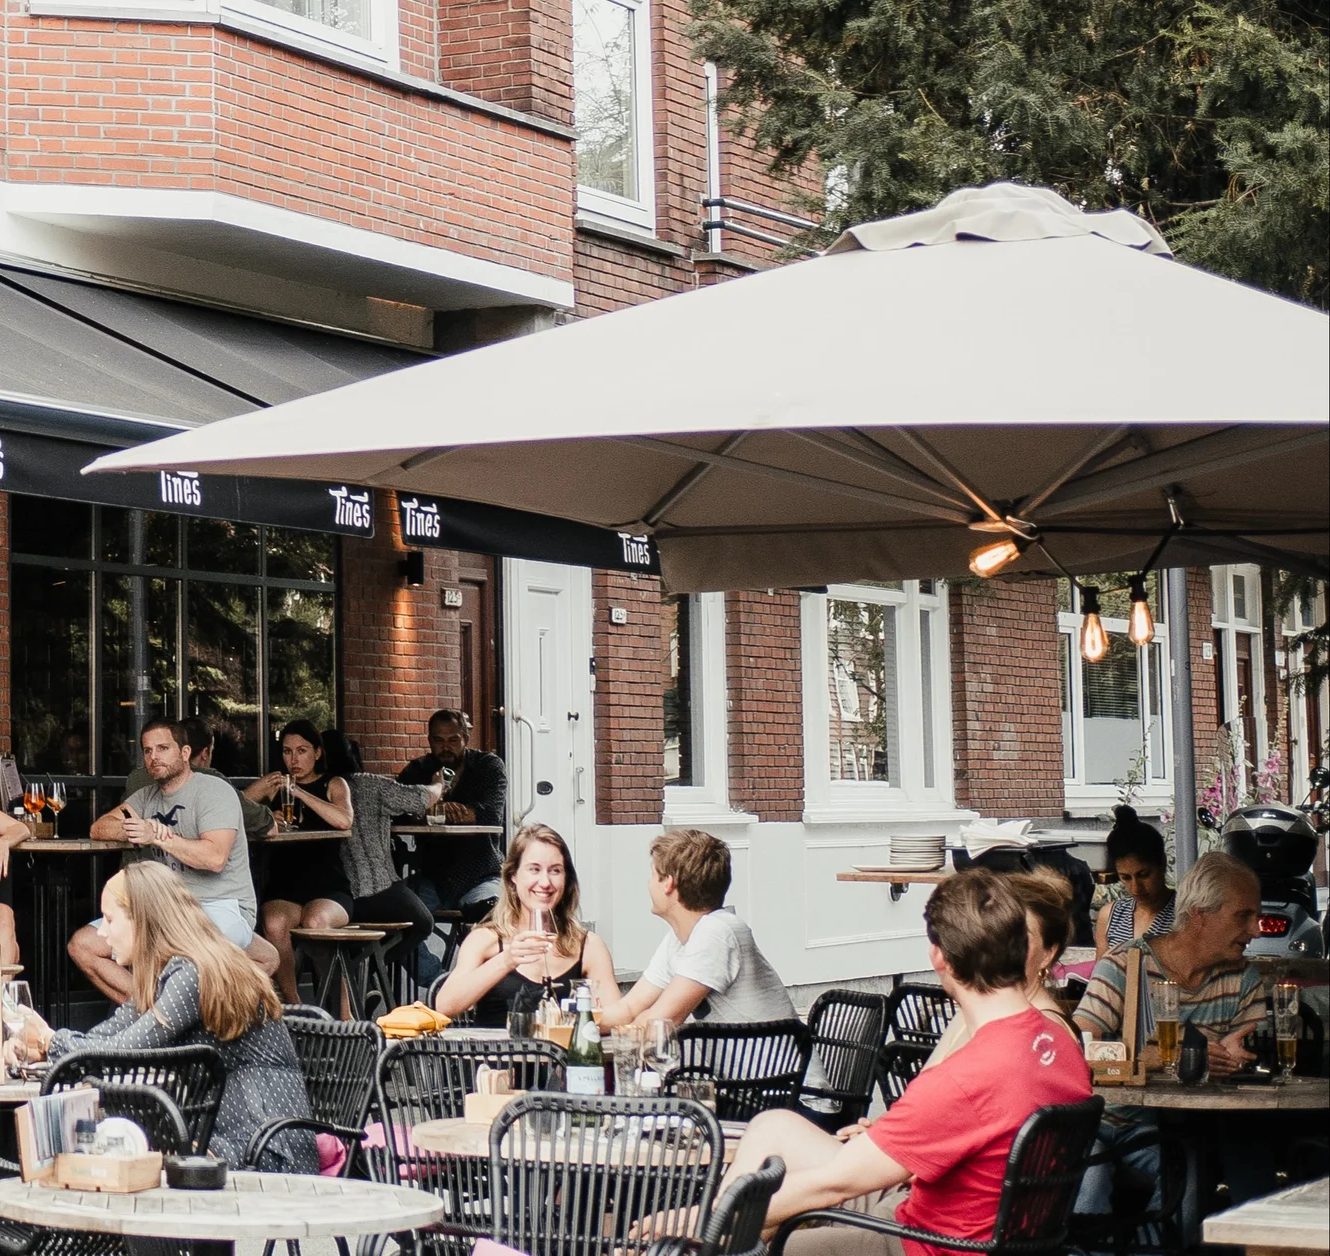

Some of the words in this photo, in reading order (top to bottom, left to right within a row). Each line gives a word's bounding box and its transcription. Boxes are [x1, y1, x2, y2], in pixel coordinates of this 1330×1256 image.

[328, 485, 371, 528] Tines
[401, 498, 441, 538] Tines
[617, 532, 651, 566] Tines
